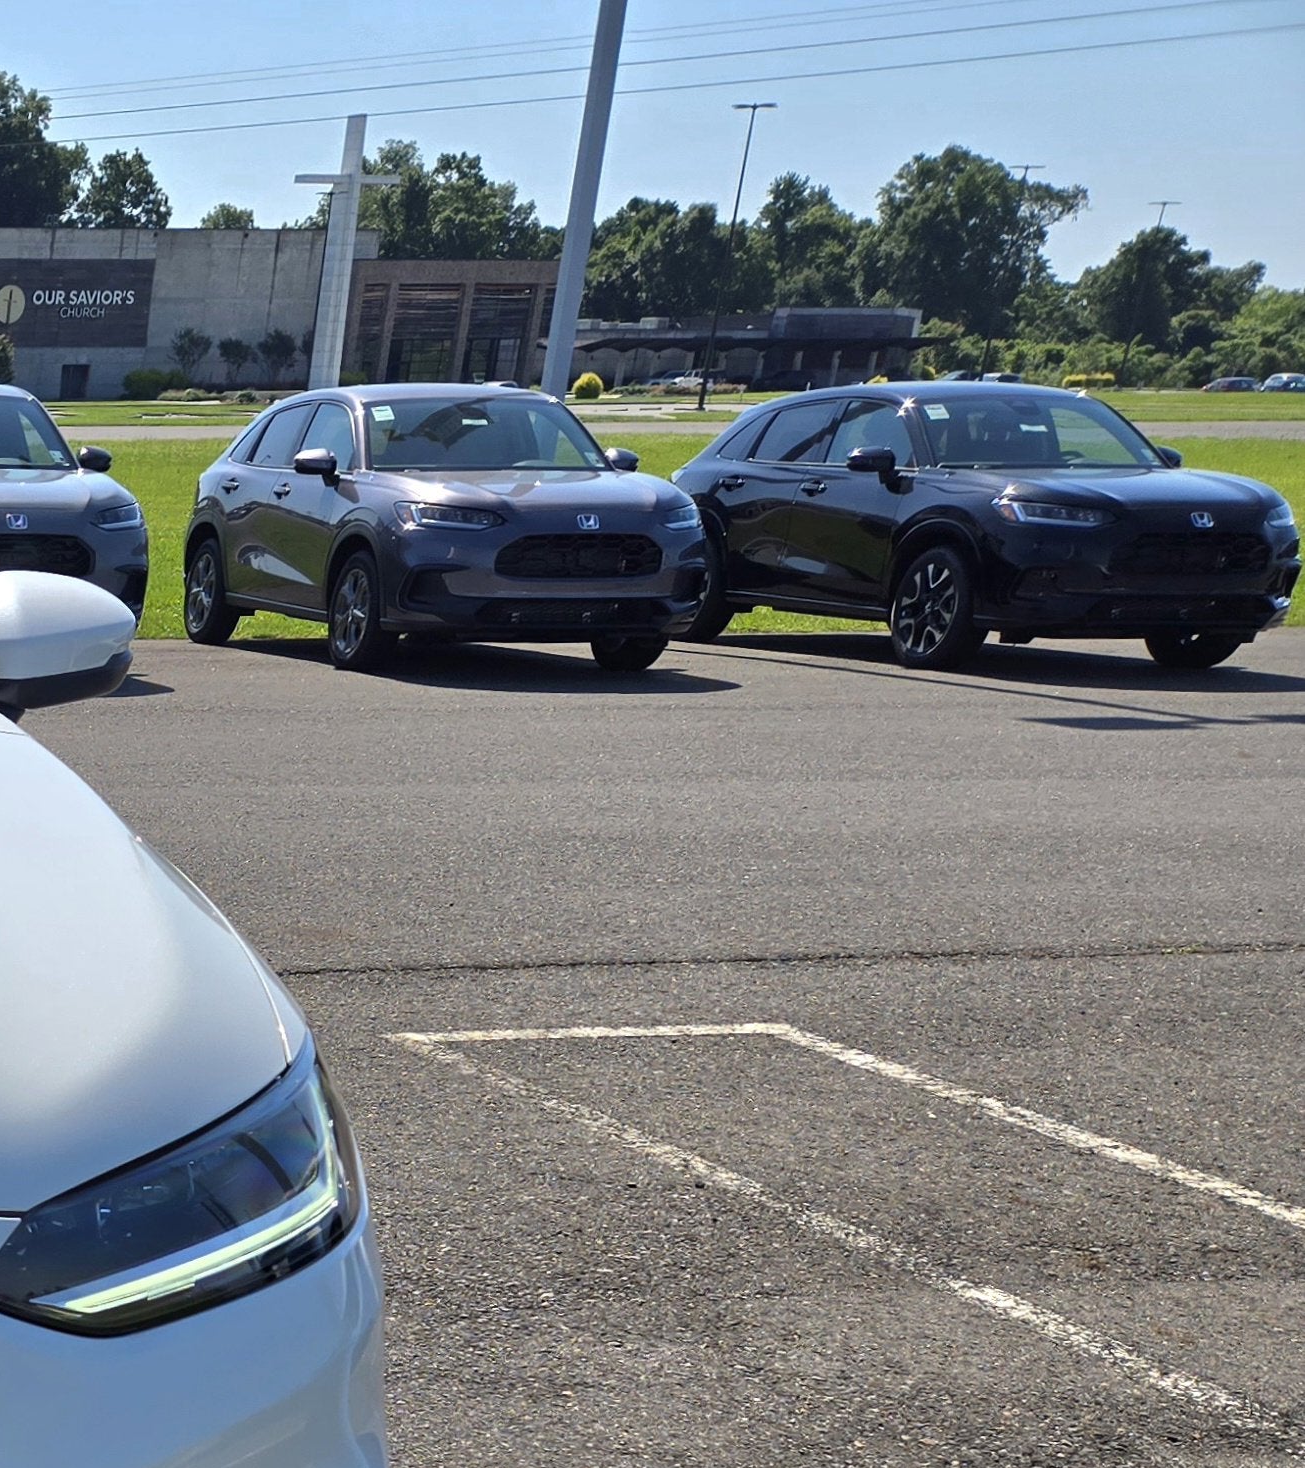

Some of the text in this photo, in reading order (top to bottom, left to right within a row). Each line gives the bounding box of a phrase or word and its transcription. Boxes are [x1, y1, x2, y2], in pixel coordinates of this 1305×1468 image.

[32, 290, 135, 305] OUR SAVIOR'S
[60, 307, 105, 318] CHURCH
